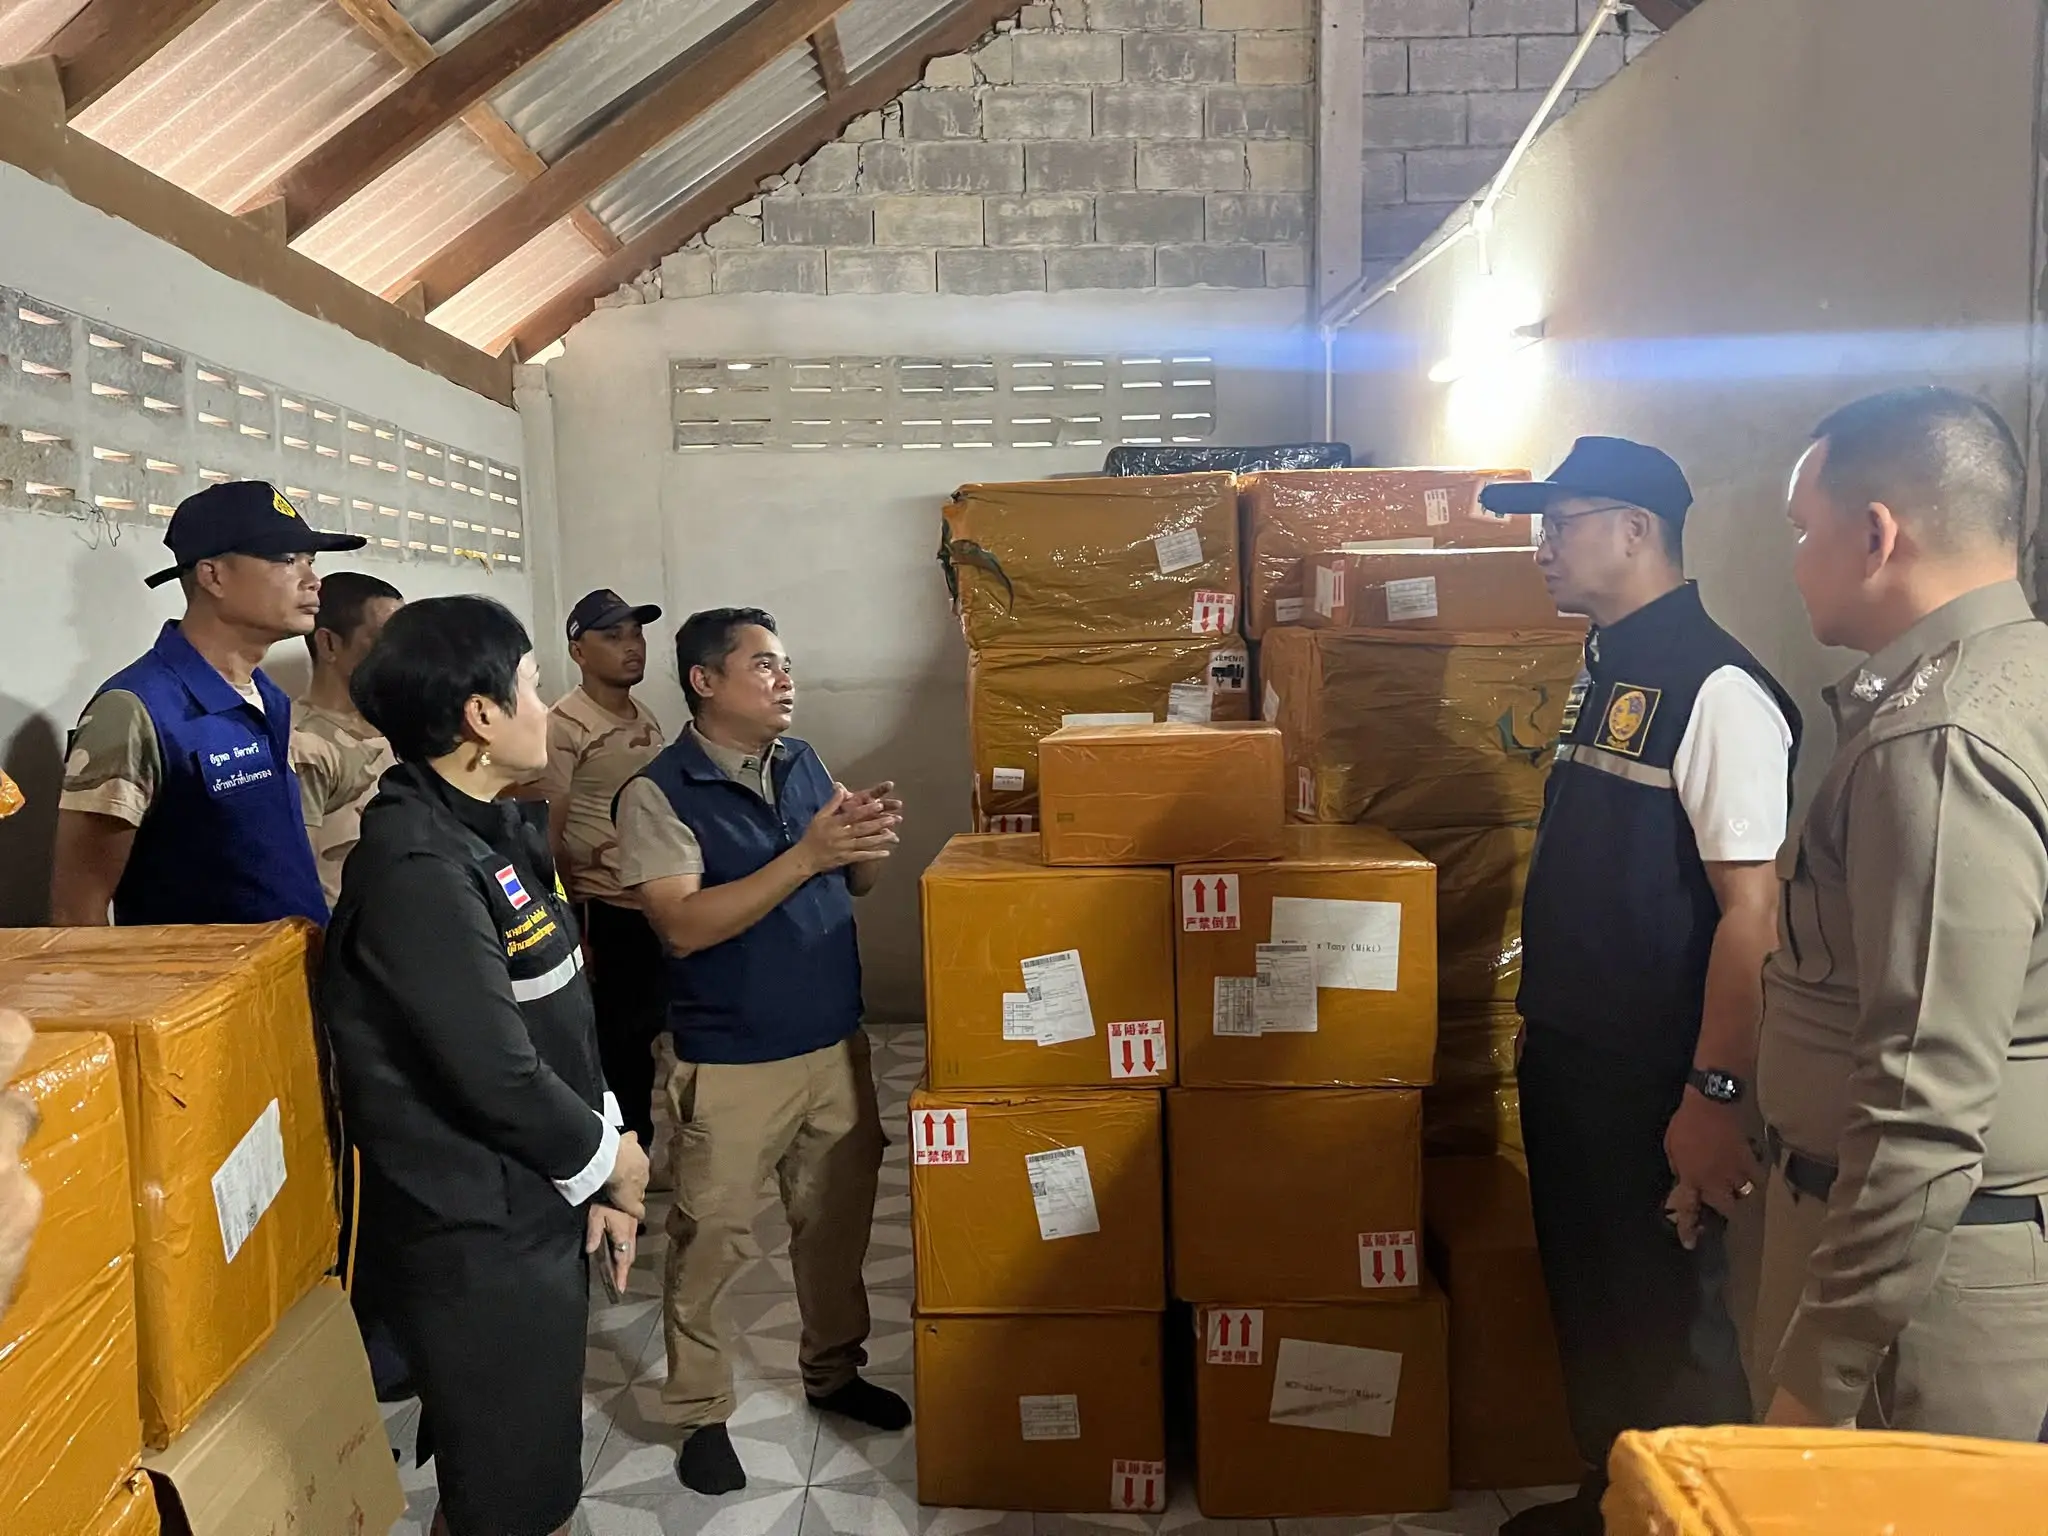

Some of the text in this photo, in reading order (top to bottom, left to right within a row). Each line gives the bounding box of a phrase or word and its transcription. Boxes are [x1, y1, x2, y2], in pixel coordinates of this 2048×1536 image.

[1185, 916, 1237, 930] 严禁倒置
[1327, 942, 1346, 951] Tony
[916, 1149, 967, 1163] 严禁倒置
